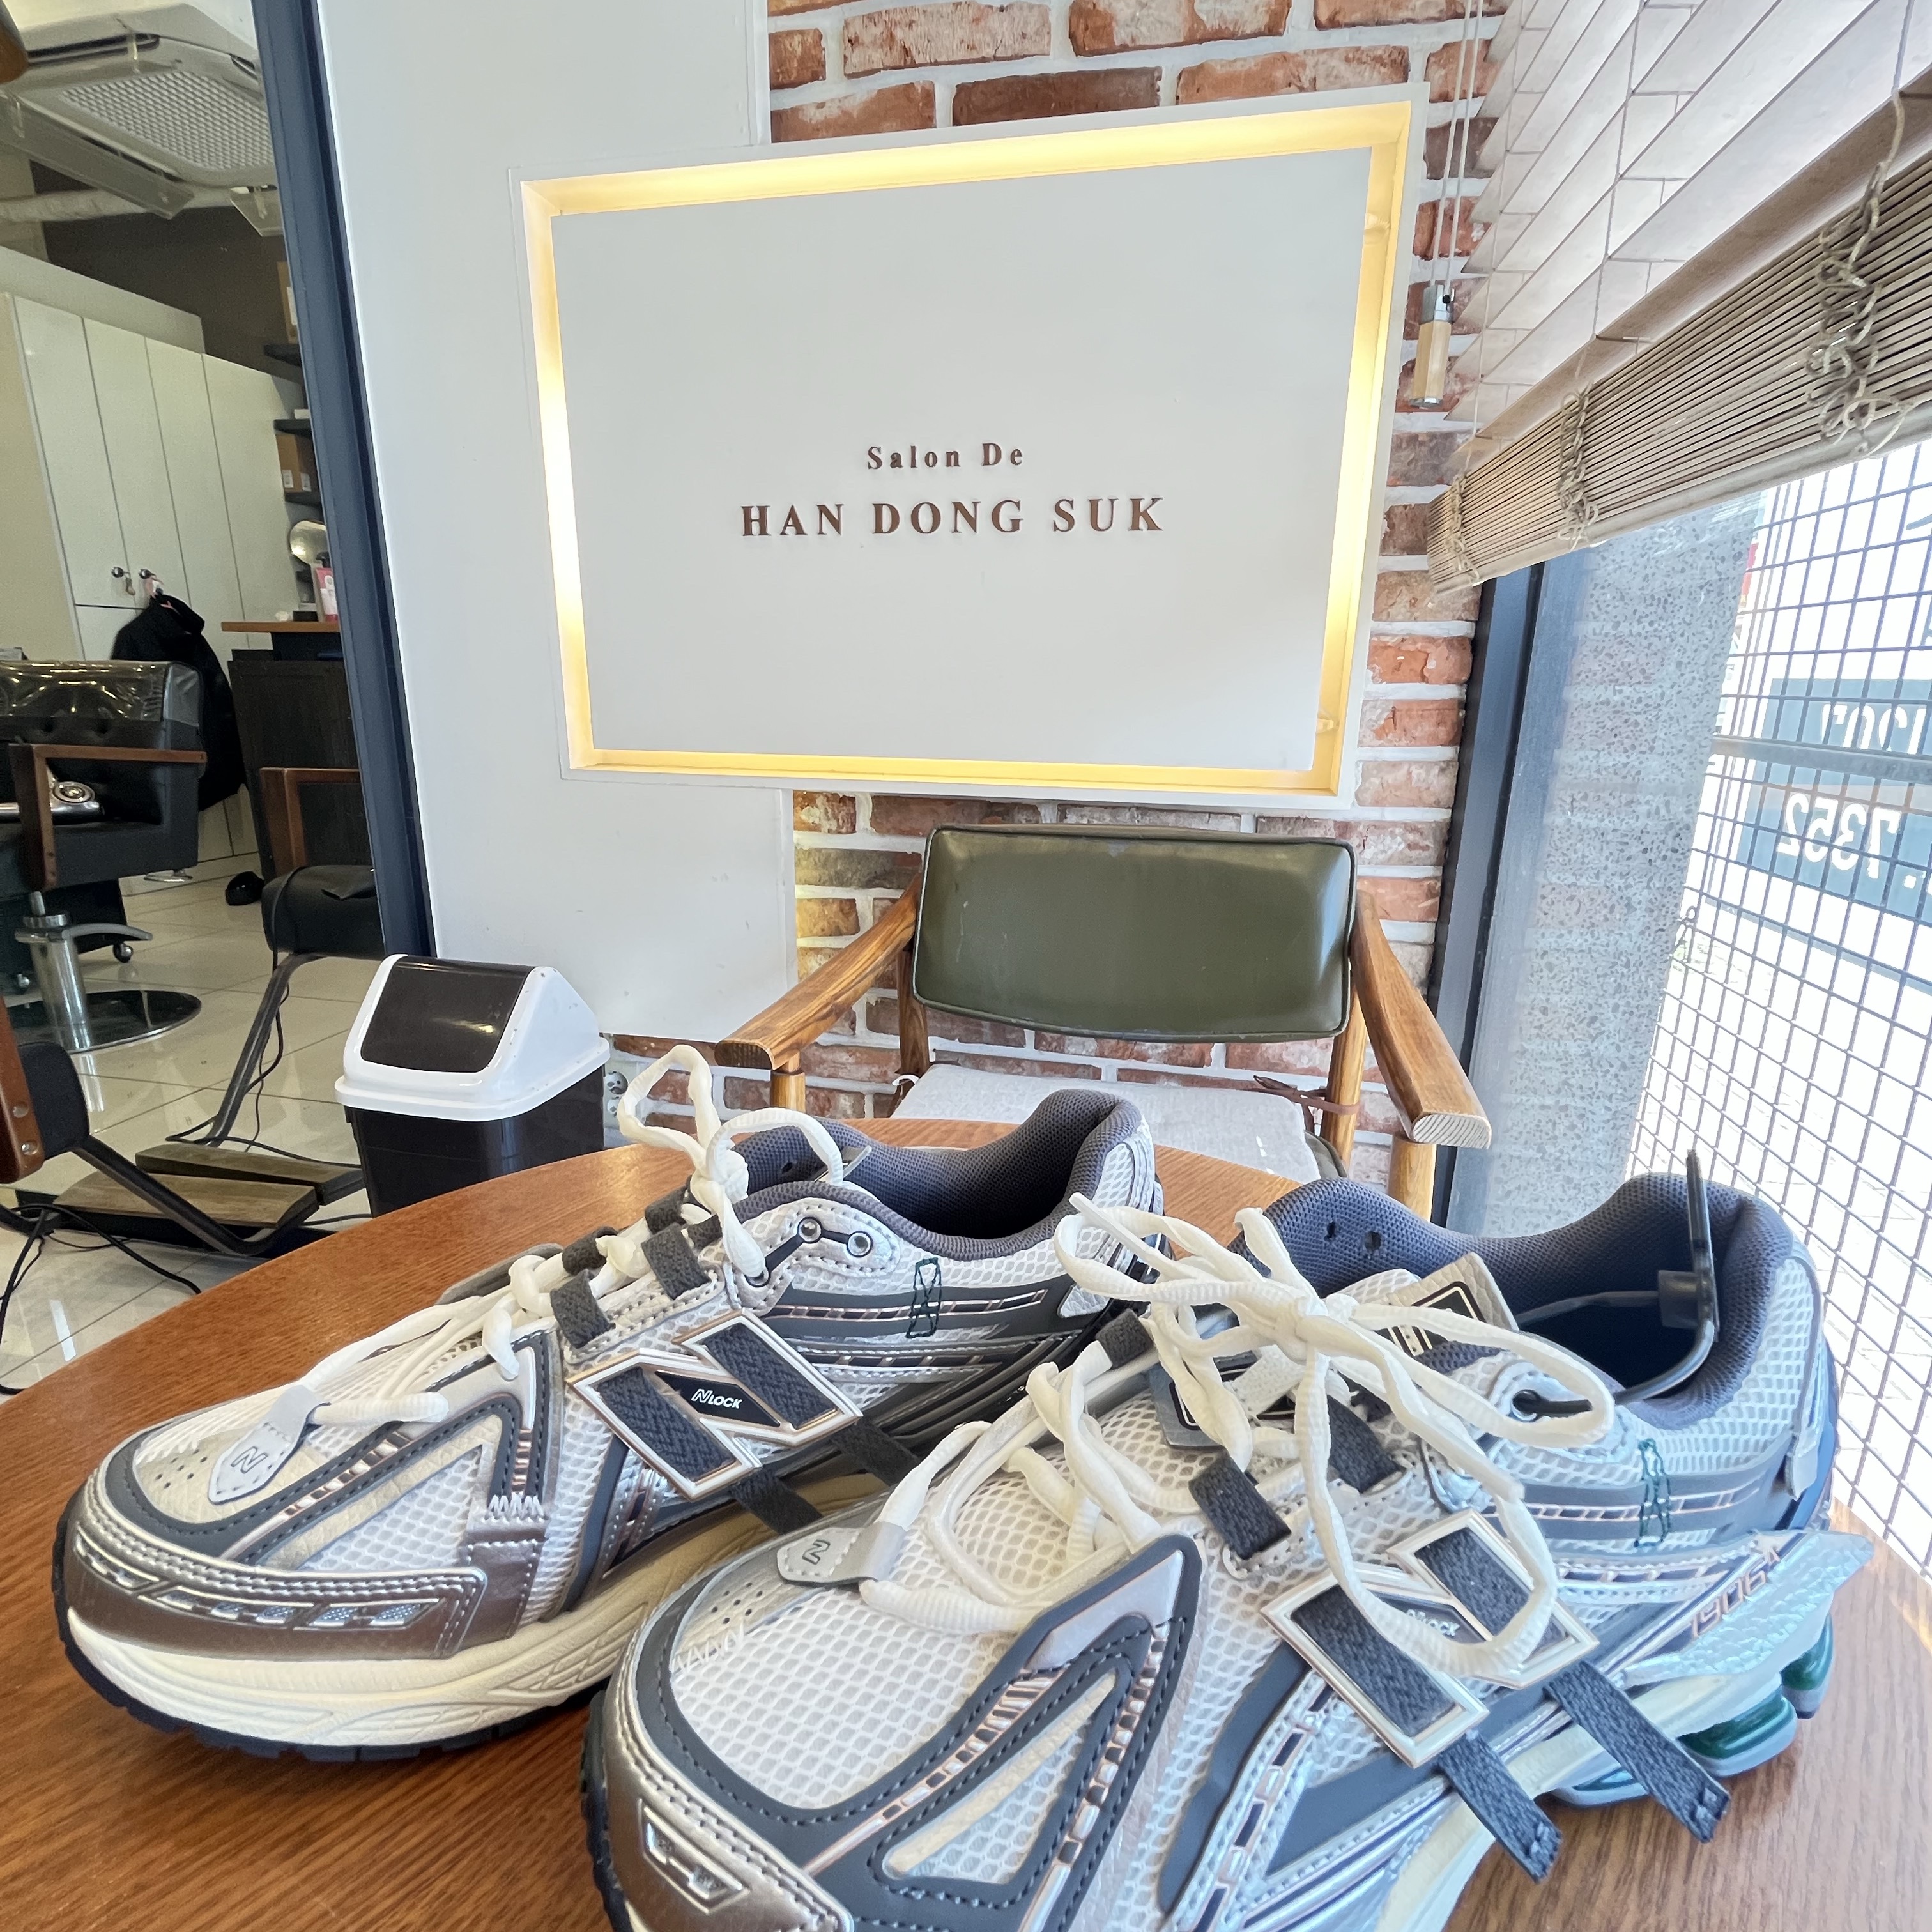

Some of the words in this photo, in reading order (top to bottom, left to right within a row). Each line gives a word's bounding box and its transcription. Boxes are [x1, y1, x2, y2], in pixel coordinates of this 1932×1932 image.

[868, 446, 960, 469] Salon
[982, 443, 1022, 466] De
[741, 504, 843, 536] HAN
[872, 500, 1023, 534] DONG
[1054, 498, 1163, 532] SUK
[691, 1388, 743, 1409] NLOCK
